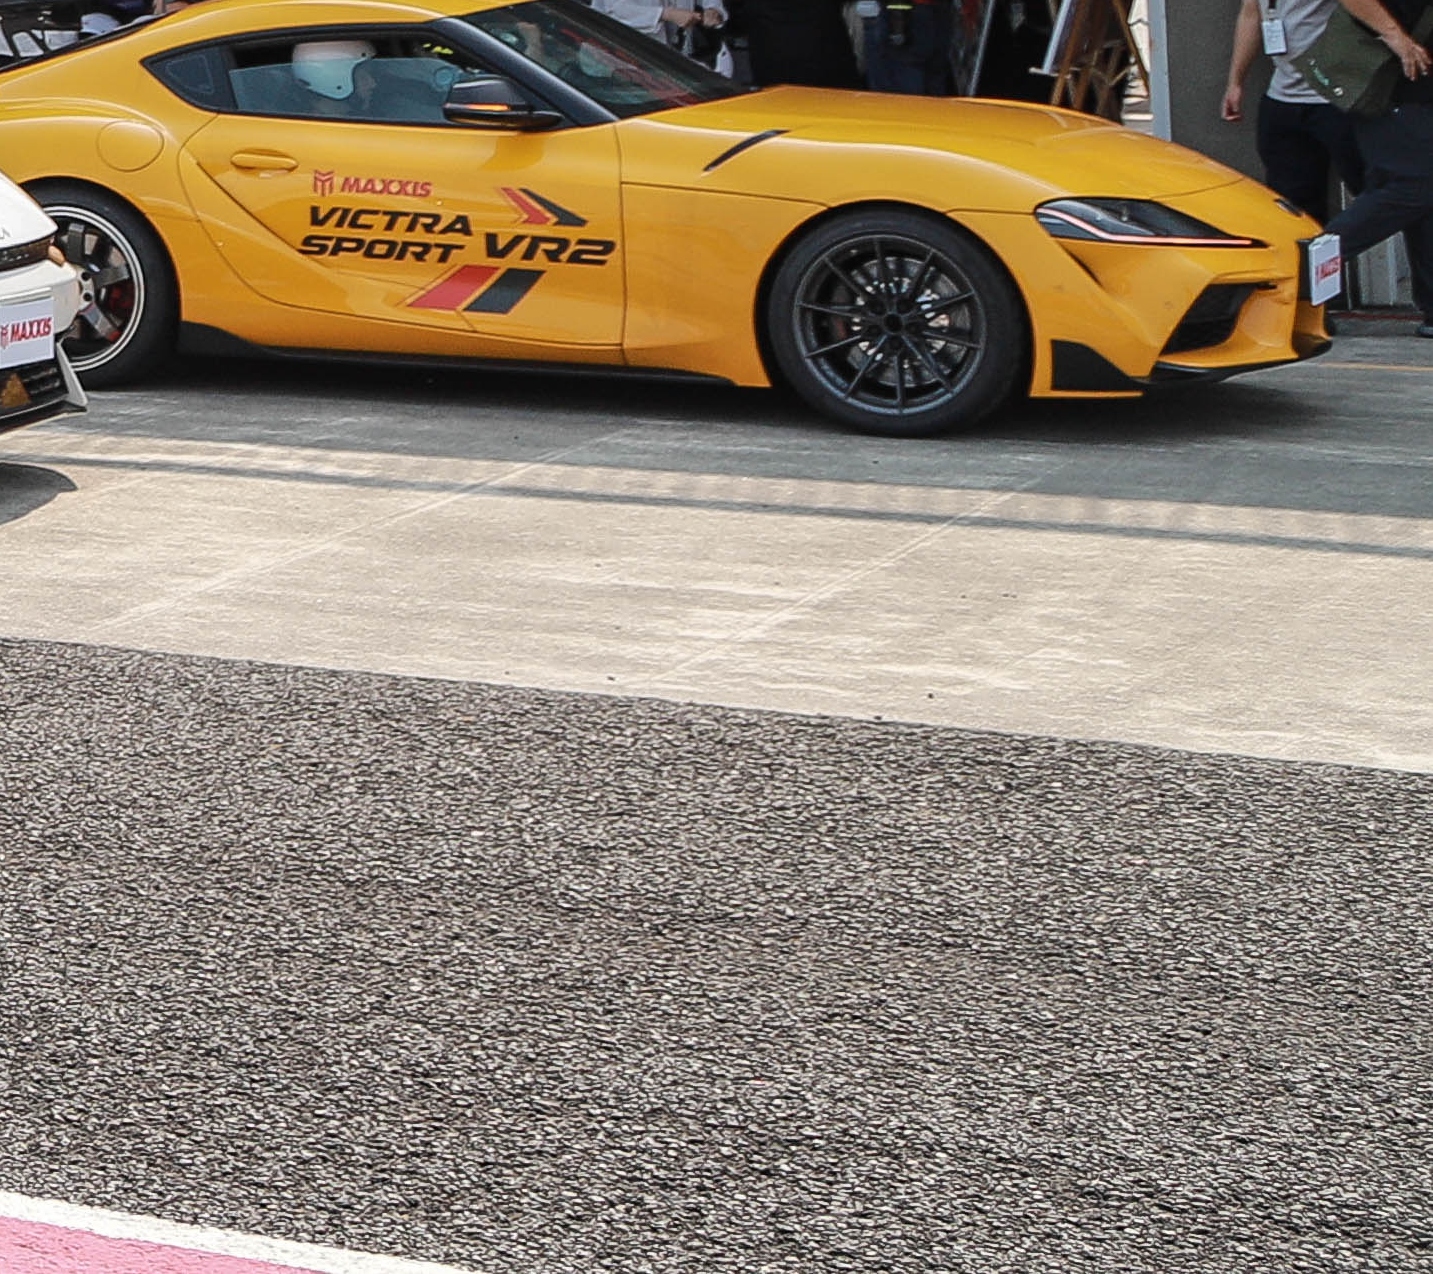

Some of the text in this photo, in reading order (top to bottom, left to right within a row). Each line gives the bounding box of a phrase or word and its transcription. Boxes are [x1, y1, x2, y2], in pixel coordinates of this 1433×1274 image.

[341, 176, 432, 197] MAXXIS
[309, 205, 474, 237] VICTRA
[300, 233, 617, 264] SPORT VR2
[10, 317, 51, 342] MAXXIS
